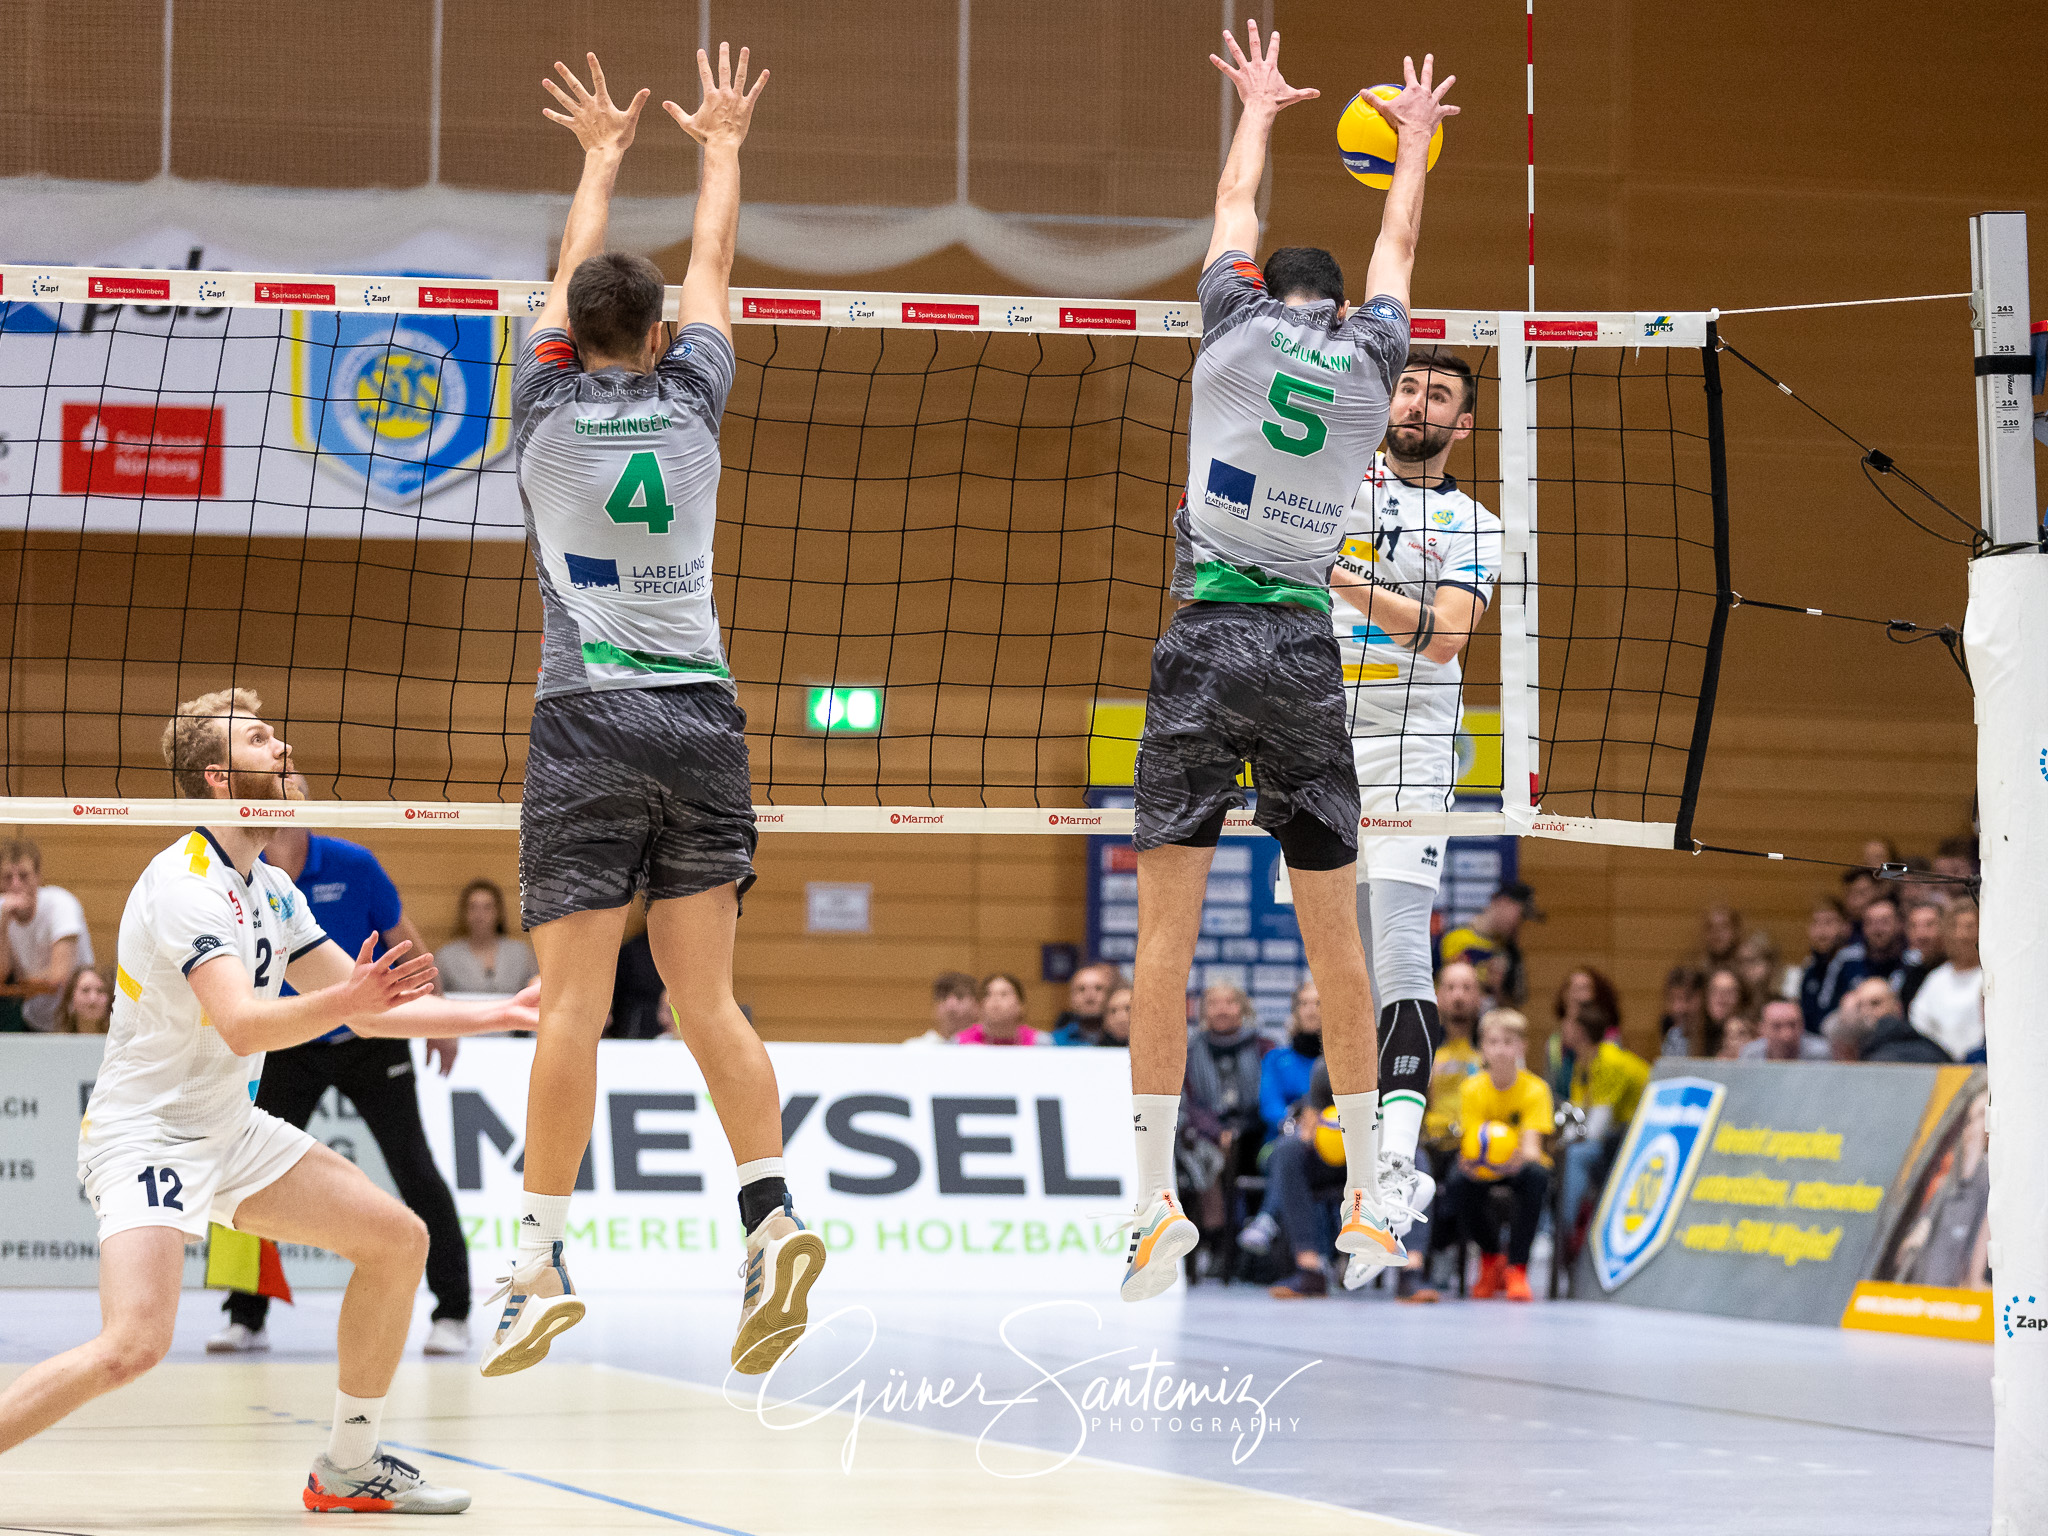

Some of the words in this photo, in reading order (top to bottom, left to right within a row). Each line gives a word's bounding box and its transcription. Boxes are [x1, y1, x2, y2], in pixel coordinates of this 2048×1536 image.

[41, 284, 59, 293] Zapf
[105, 286, 135, 295] Sparkasse
[136, 287, 165, 296] Nürnberg
[207, 290, 226, 299] Zapf
[271, 291, 302, 300] Sparkasse
[302, 292, 330, 301] Nürnberg
[372, 294, 391, 303] Zapf
[435, 296, 465, 305] Sparkasse
[465, 297, 493, 306] Nürnberg
[535, 300, 545, 308] Za
[759, 307, 788, 315] Sparkasse
[788, 308, 816, 317] Nürnberg
[857, 310, 875, 319] Zapf
[918, 311, 947, 320] Sparkasse
[947, 313, 975, 321] Nürnberg
[1014, 315, 1033, 324] Zapf
[1075, 316, 1104, 325] Sparkasse
[1104, 317, 1132, 326] Nürnberg
[1171, 319, 1190, 328] Zapf
[1414, 326, 1441, 335] Nürnberg
[1479, 328, 1497, 337] Zapf
[1538, 328, 1567, 337] Sparkasse
[1567, 329, 1593, 338] Nürnberg
[1644, 324, 1673, 332] HUCK
[1271, 331, 1351, 373] SCHUMANN
[1260, 370, 1335, 458] 5
[574, 413, 674, 437] GEHRINGER
[603, 450, 676, 535] 4
[1266, 487, 1344, 518] LABELLING
[1262, 506, 1338, 536] SPECIALIST
[632, 555, 705, 579] LABELLING
[1335, 555, 1364, 574] Zapf
[634, 575, 705, 595] SPECIALIST
[85, 806, 129, 815] Marmot
[251, 808, 295, 818] Marmot
[417, 809, 460, 819] Marmot
[756, 813, 784, 822] rmot
[901, 814, 944, 824] Marmot
[1060, 815, 1102, 825] Marmot
[1223, 818, 1253, 826] armo
[1371, 818, 1412, 828] Marmot
[1532, 822, 1565, 831] armot
[137, 1166, 184, 1212] 12
[460, 1216, 718, 1251] ZIMEREI
[876, 1219, 1127, 1254] HOLZBAU
[2016, 1314, 2048, 1331] Zap
